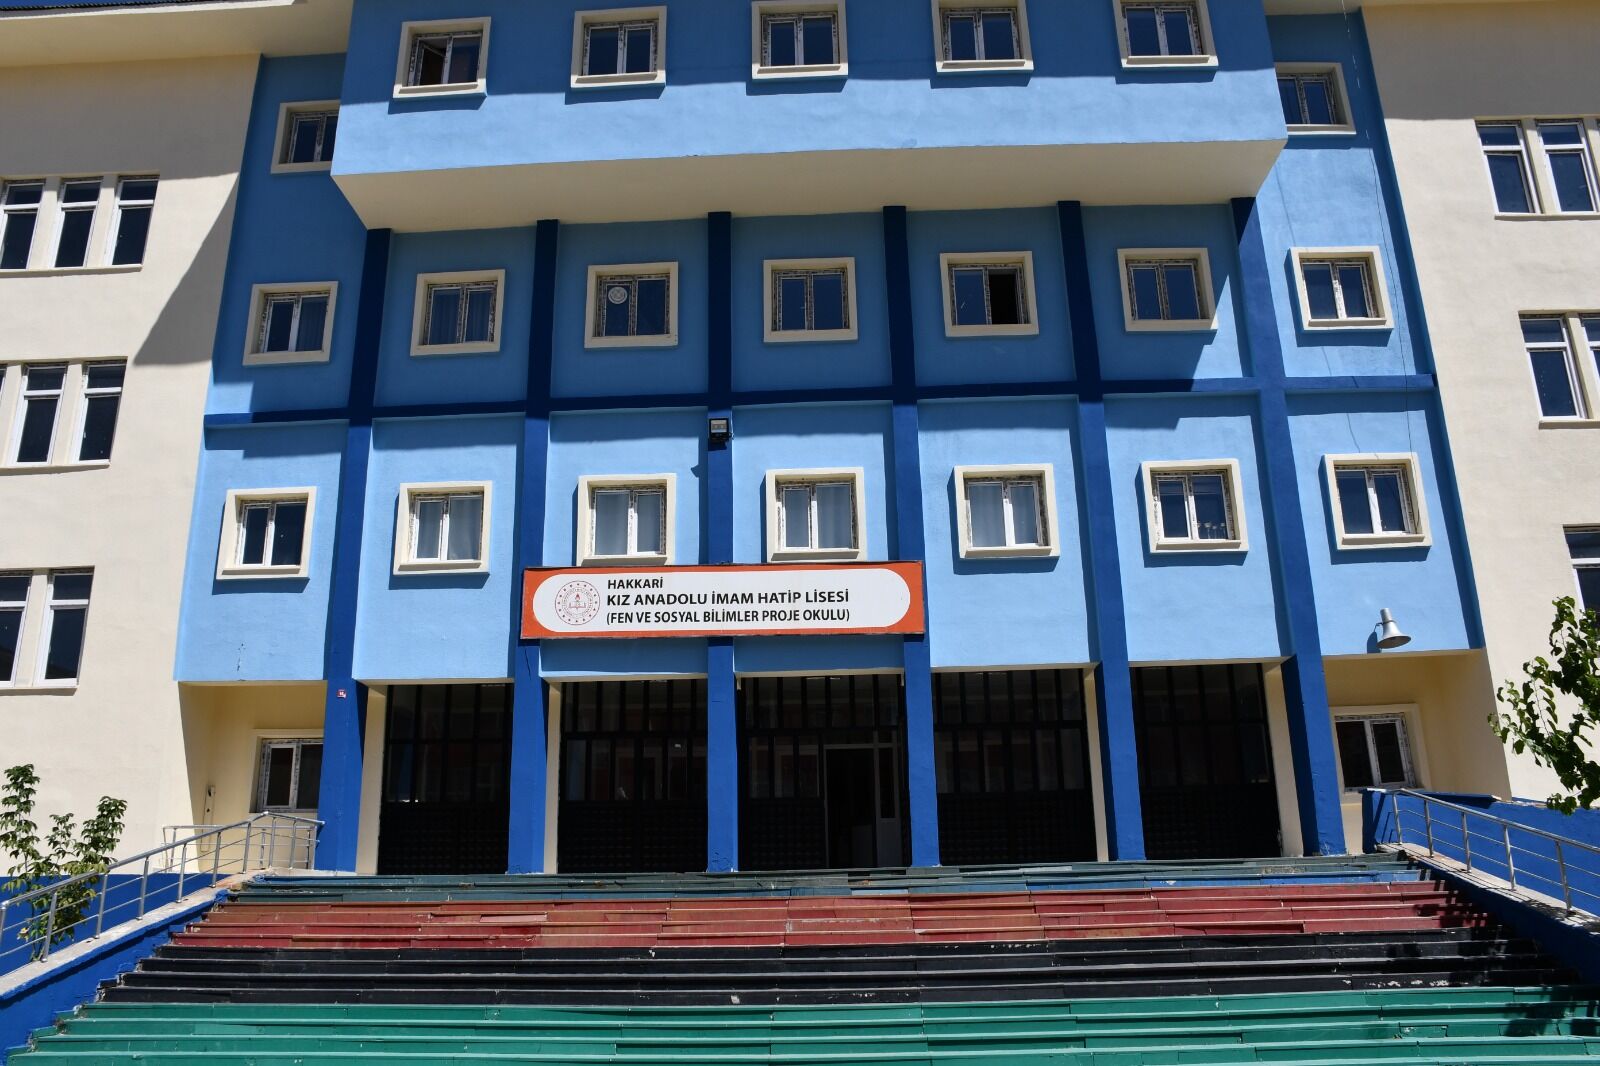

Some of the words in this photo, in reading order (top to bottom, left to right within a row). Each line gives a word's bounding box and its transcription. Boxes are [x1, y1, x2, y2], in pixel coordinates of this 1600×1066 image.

[607, 576, 664, 590] HAKKARİ
[606, 594, 631, 606] KIZ
[633, 593, 708, 606] ANADOLU
[711, 590, 754, 605] İMAM
[757, 589, 802, 604] HATİP
[805, 588, 849, 603] LİSESİ
[606, 612, 634, 626] (FEN
[635, 611, 652, 624] VE
[654, 611, 701, 624] SOSYAL
[703, 608, 759, 623] BİLİMLER
[761, 609, 801, 622] PROJE
[802, 608, 850, 622] OKULU)
